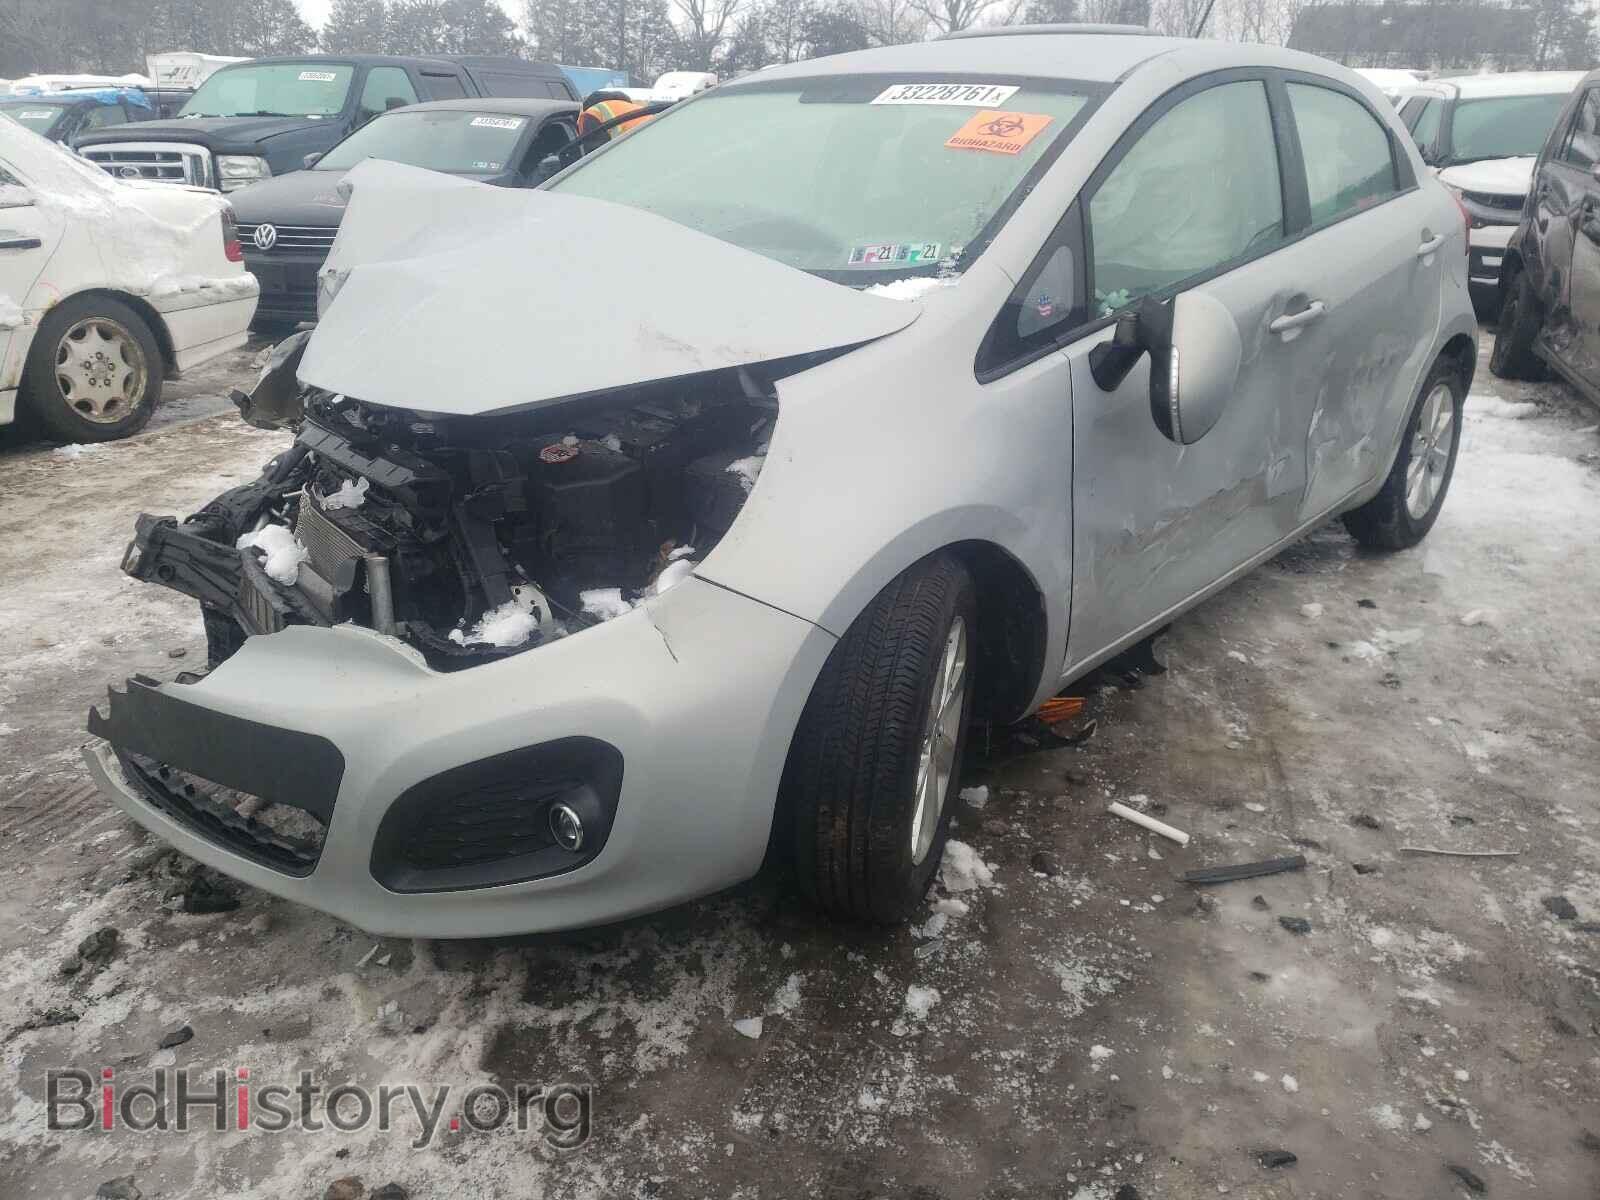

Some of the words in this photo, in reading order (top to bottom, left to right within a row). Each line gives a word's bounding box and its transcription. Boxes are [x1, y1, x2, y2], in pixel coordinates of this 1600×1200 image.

[891, 85, 997, 102] 33228761
[949, 137, 1022, 151] BIOHAZARD
[879, 246, 892, 260] 21
[922, 244, 936, 258] 21
